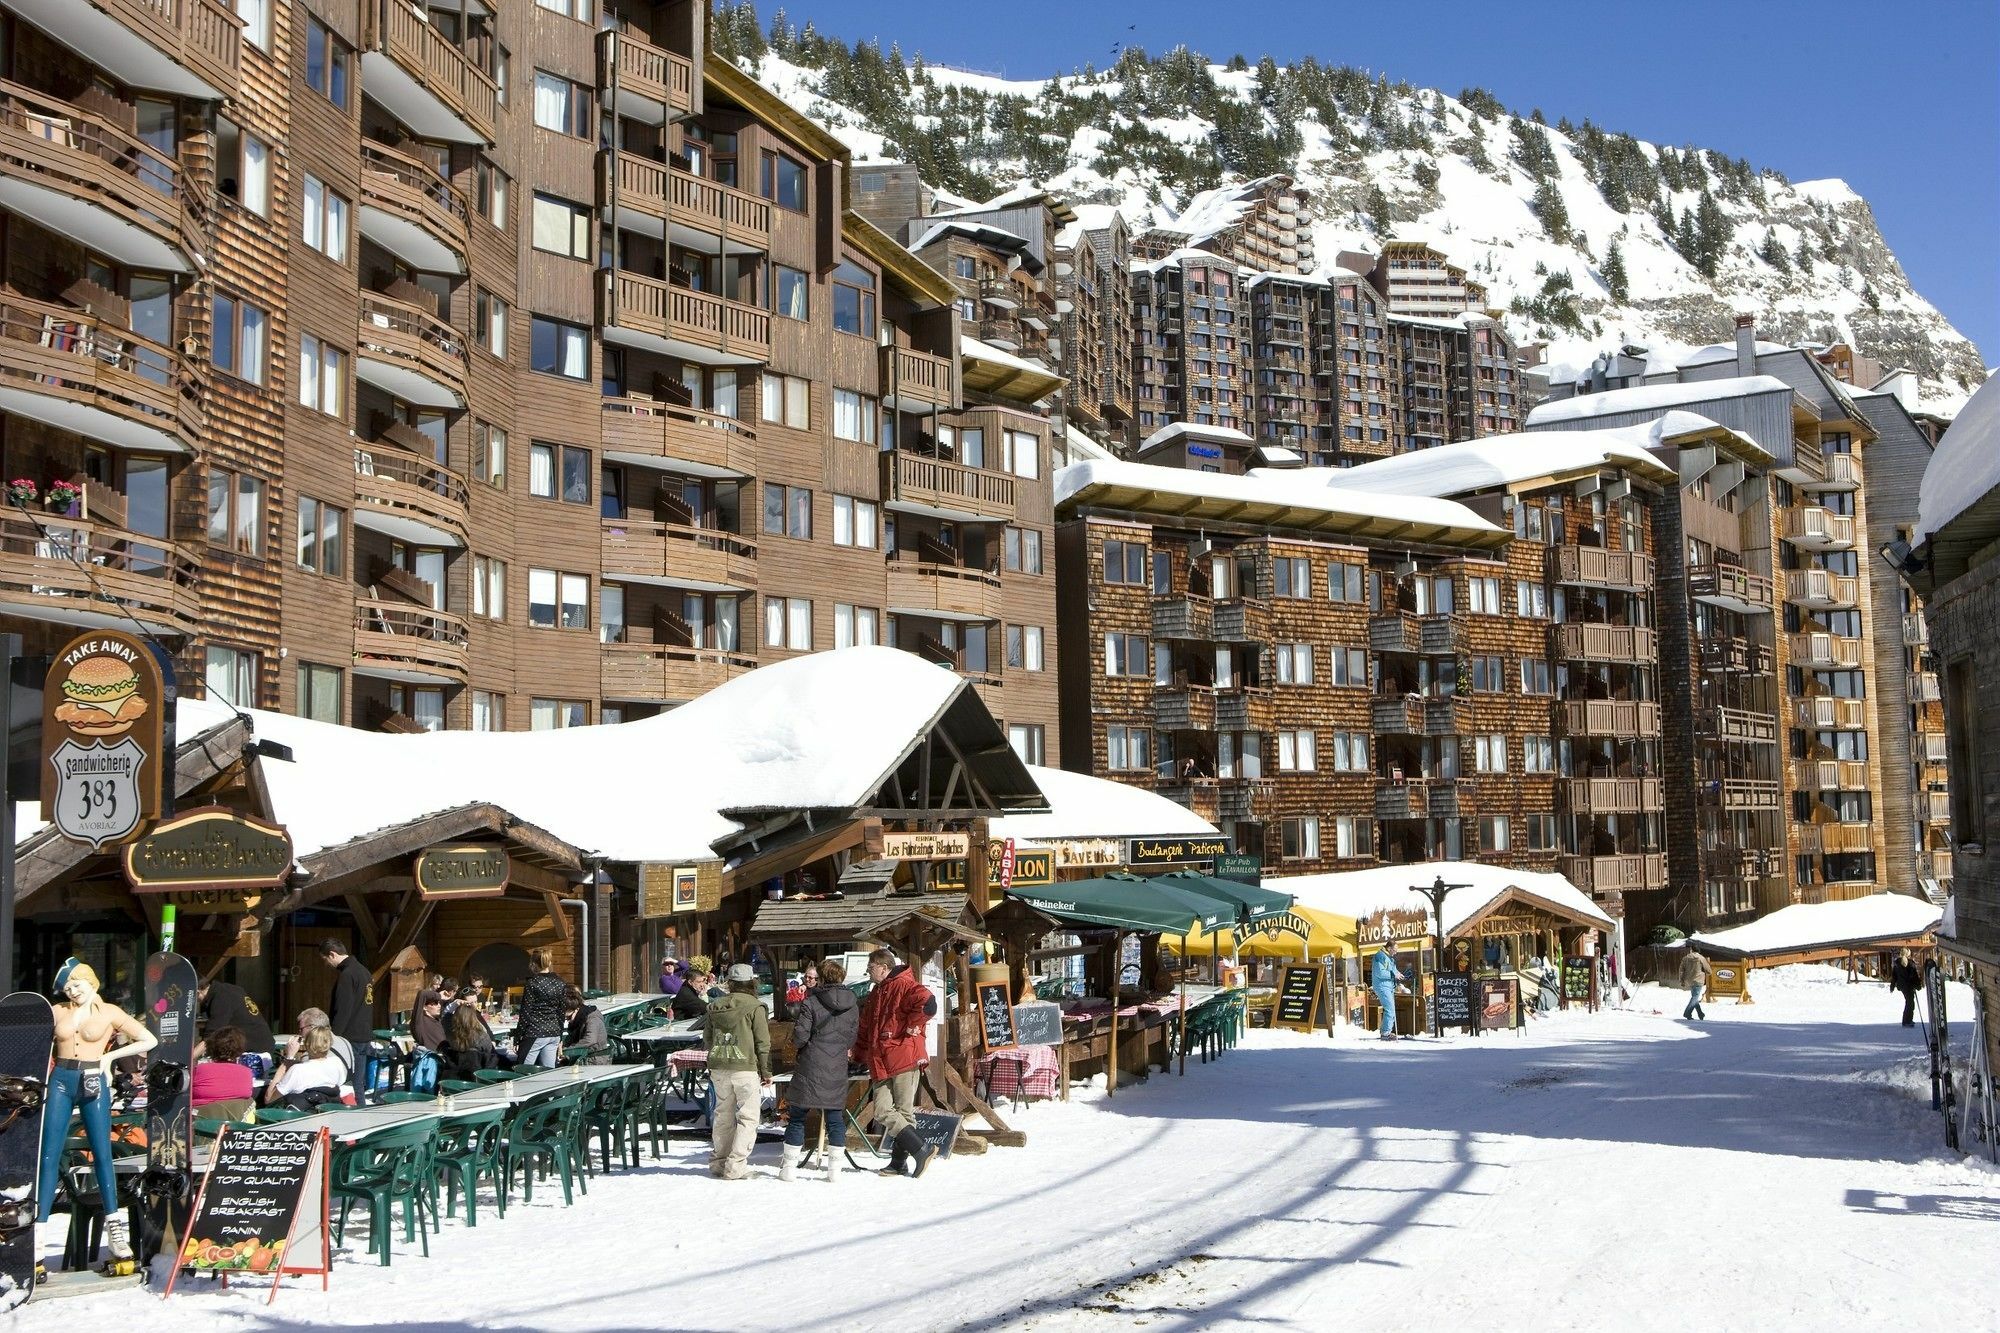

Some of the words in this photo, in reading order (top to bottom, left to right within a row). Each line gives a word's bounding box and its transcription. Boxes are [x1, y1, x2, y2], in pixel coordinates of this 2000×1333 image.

[64, 641, 98, 666] TAKE
[100, 640, 140, 664] AWAY
[77, 779, 117, 819] 383
[78, 821, 117, 830] AVORIAZ
[886, 842, 900, 857] Les
[1138, 841, 1184, 861] Boulangerie
[1001, 839, 1013, 887] TABAC
[1225, 858, 1237, 866] Bar
[1238, 858, 1251, 866] Pub
[428, 859, 502, 882] RESTAURANT
[946, 862, 964, 880] LE
[1032, 899, 1076, 911] Heineken
[1235, 922, 1252, 942] LE
[1359, 923, 1381, 942] AVO
[1390, 919, 1428, 939] SAVEURS
[1437, 977, 1468, 987] BURGERS
[233, 1131, 254, 1141] THE
[255, 1132, 284, 1141] ONLY
[284, 1132, 309, 1141] ONE
[223, 1141, 252, 1150] WIDE
[253, 1141, 313, 1151] SELECTION
[220, 1155, 236, 1164] 30
[240, 1155, 307, 1165] BURGERS
[216, 1176, 242, 1184] TOP
[244, 1176, 300, 1186] QUALITY
[221, 1197, 277, 1207] ENGLISH
[209, 1207, 287, 1217] BREAKFAST
[220, 1226, 262, 1235] PANINI
